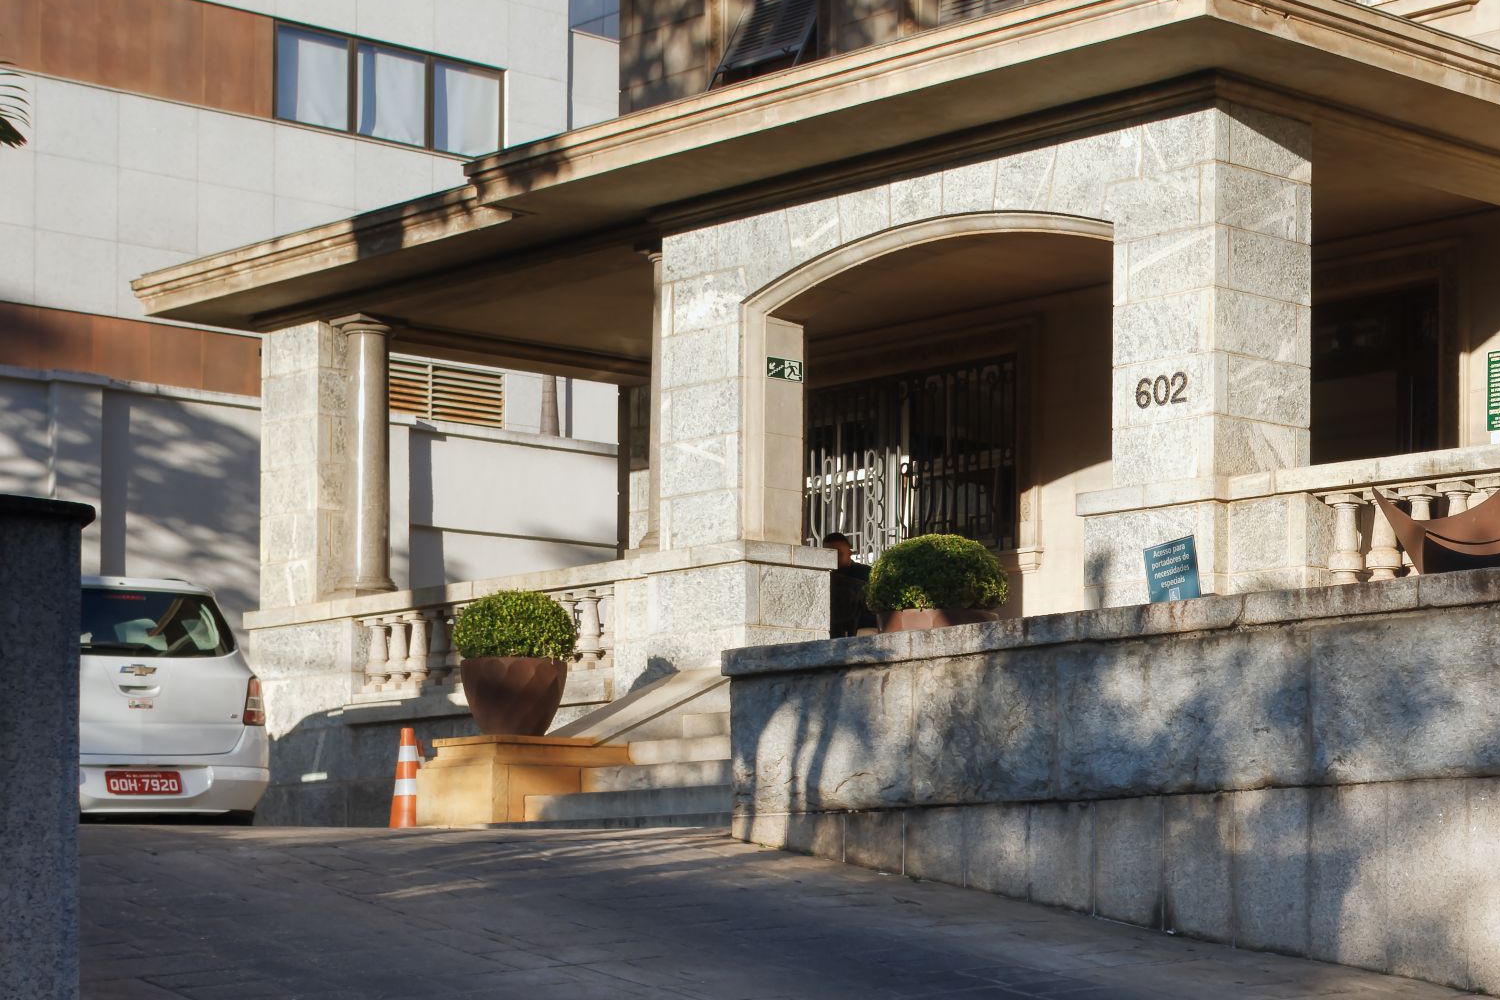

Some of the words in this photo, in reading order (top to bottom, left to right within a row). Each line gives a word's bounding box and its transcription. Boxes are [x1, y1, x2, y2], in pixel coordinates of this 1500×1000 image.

[1136, 372, 1188, 409] 602
[1153, 548, 1171, 558] Acesso
[1172, 544, 1185, 554] para
[1152, 557, 1181, 571] portadores
[1182, 552, 1190, 560] de
[1154, 564, 1190, 579] necessidades
[1161, 575, 1185, 589] especiais
